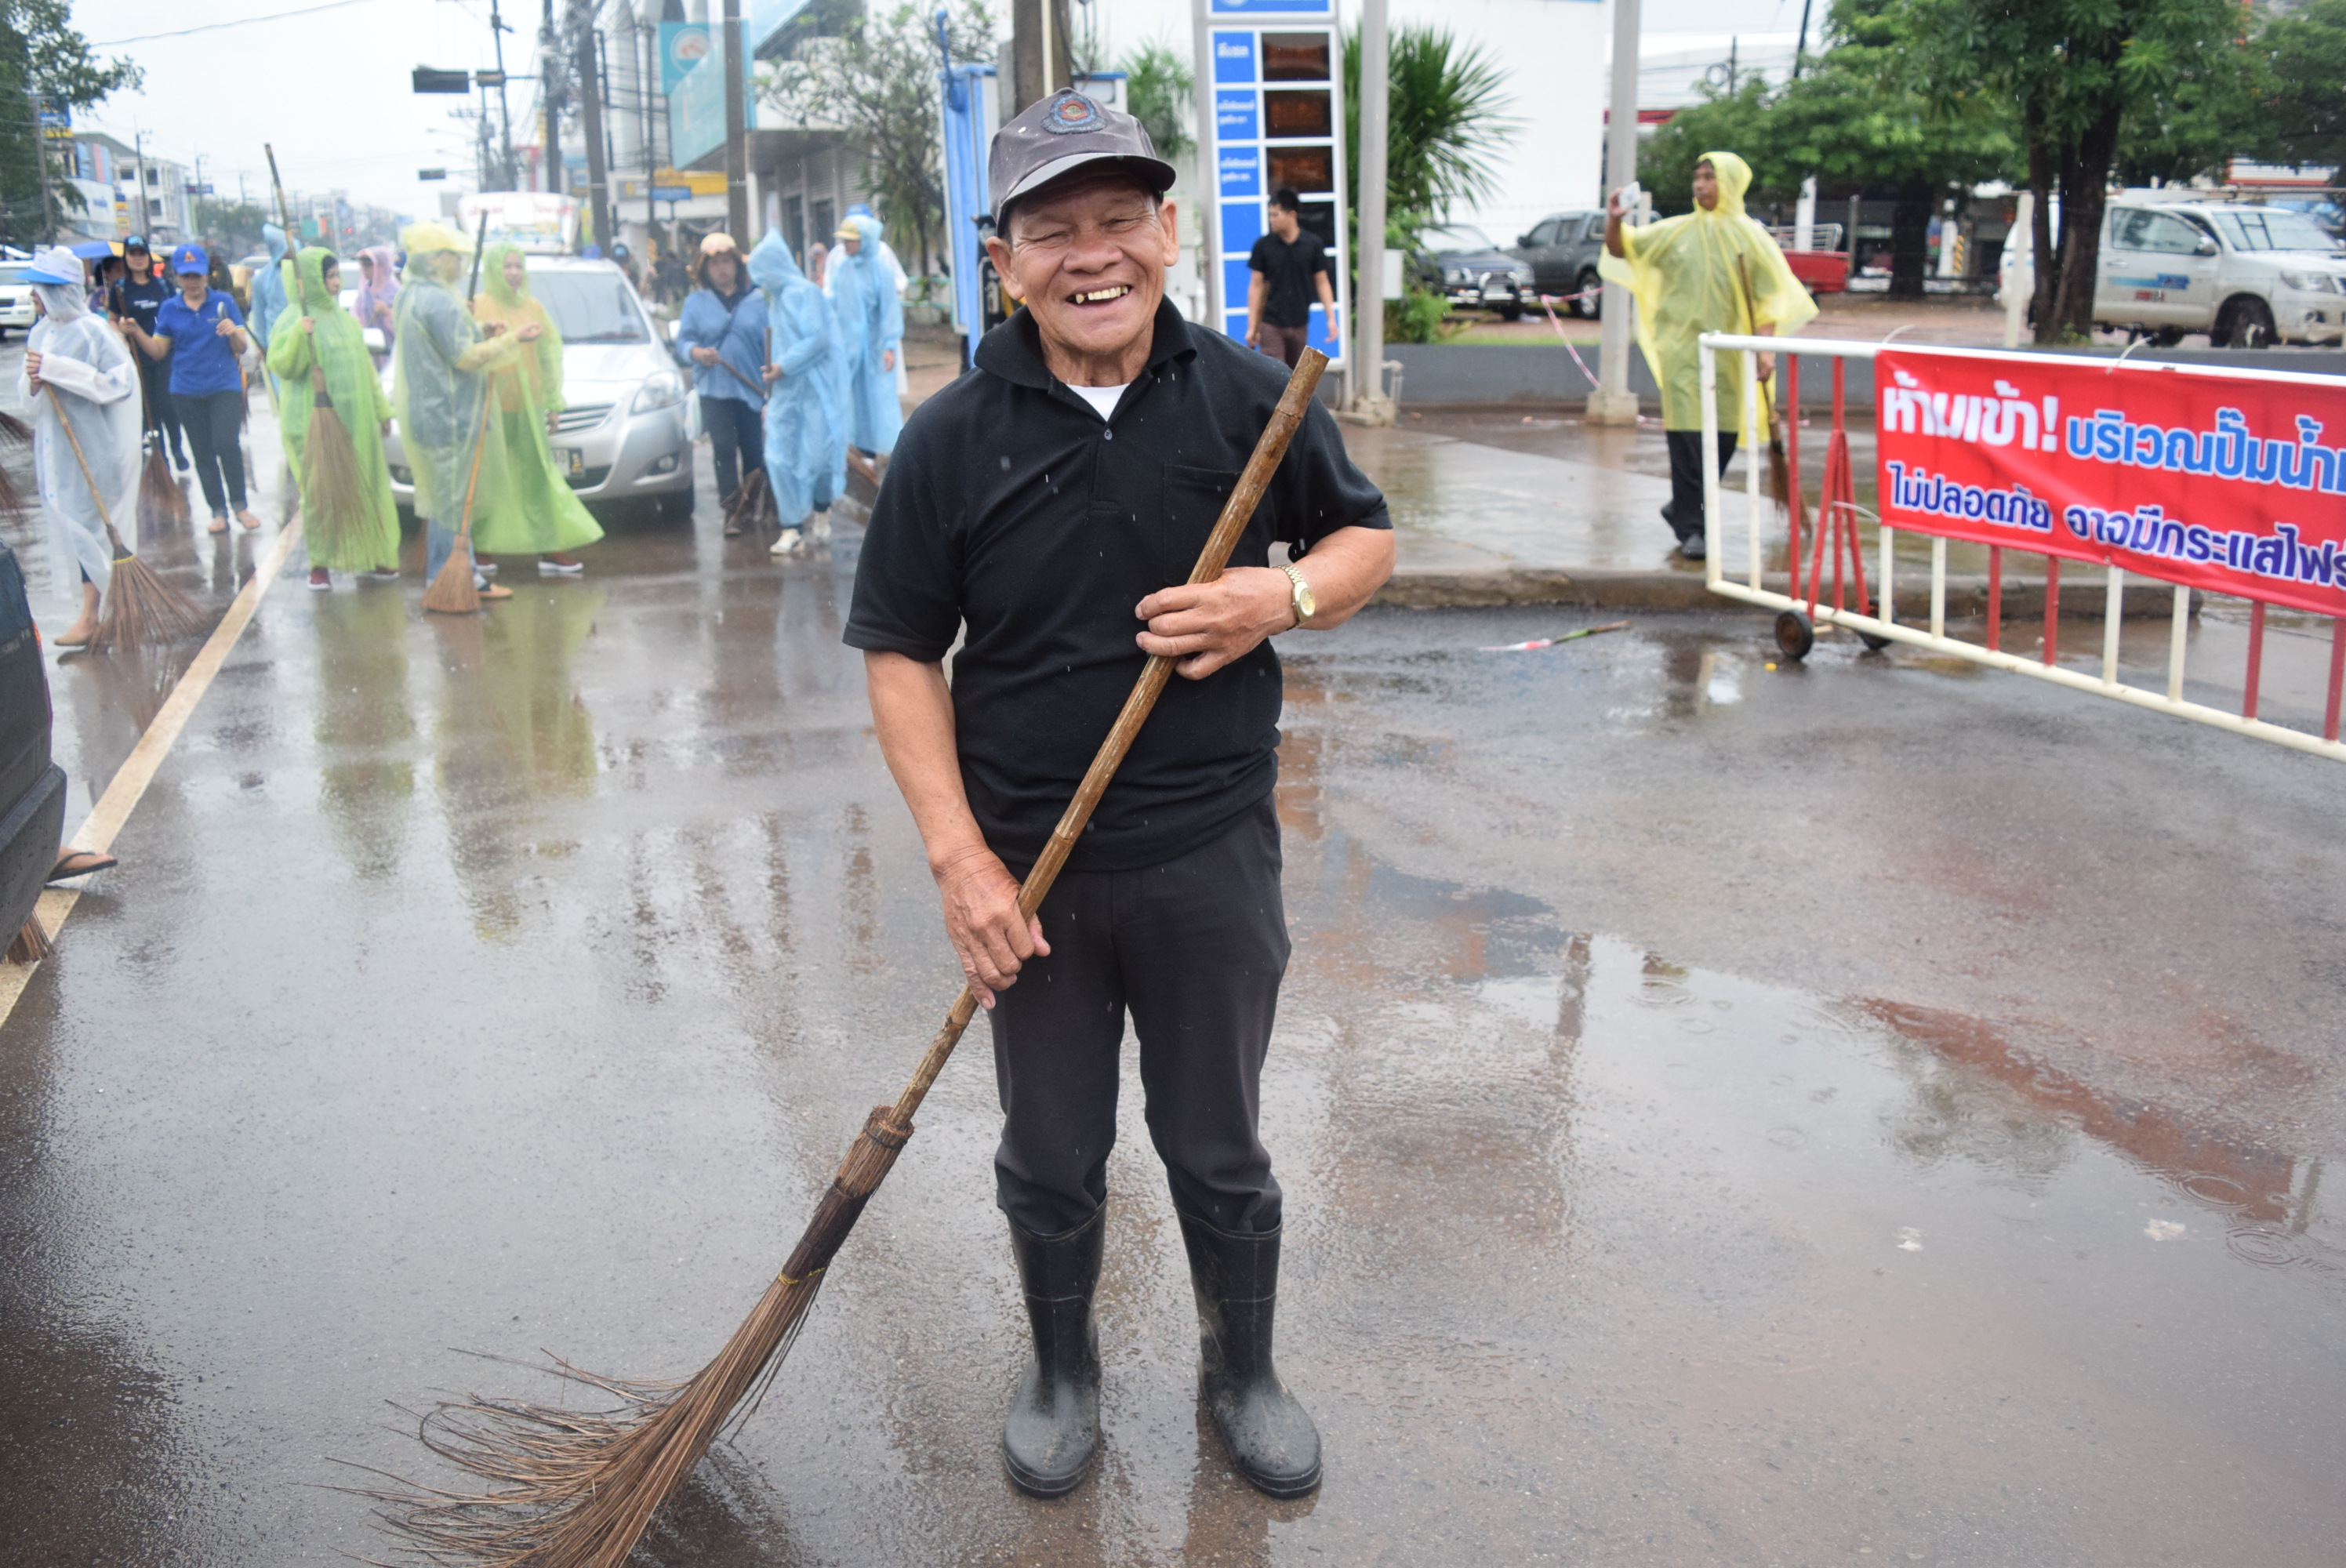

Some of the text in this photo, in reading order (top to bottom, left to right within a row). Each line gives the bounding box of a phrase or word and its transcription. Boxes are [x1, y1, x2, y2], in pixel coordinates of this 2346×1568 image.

[1883, 370, 2059, 453] ห้ามเข้า!
[1888, 462, 2051, 531] ไม่ปลอดภัย
